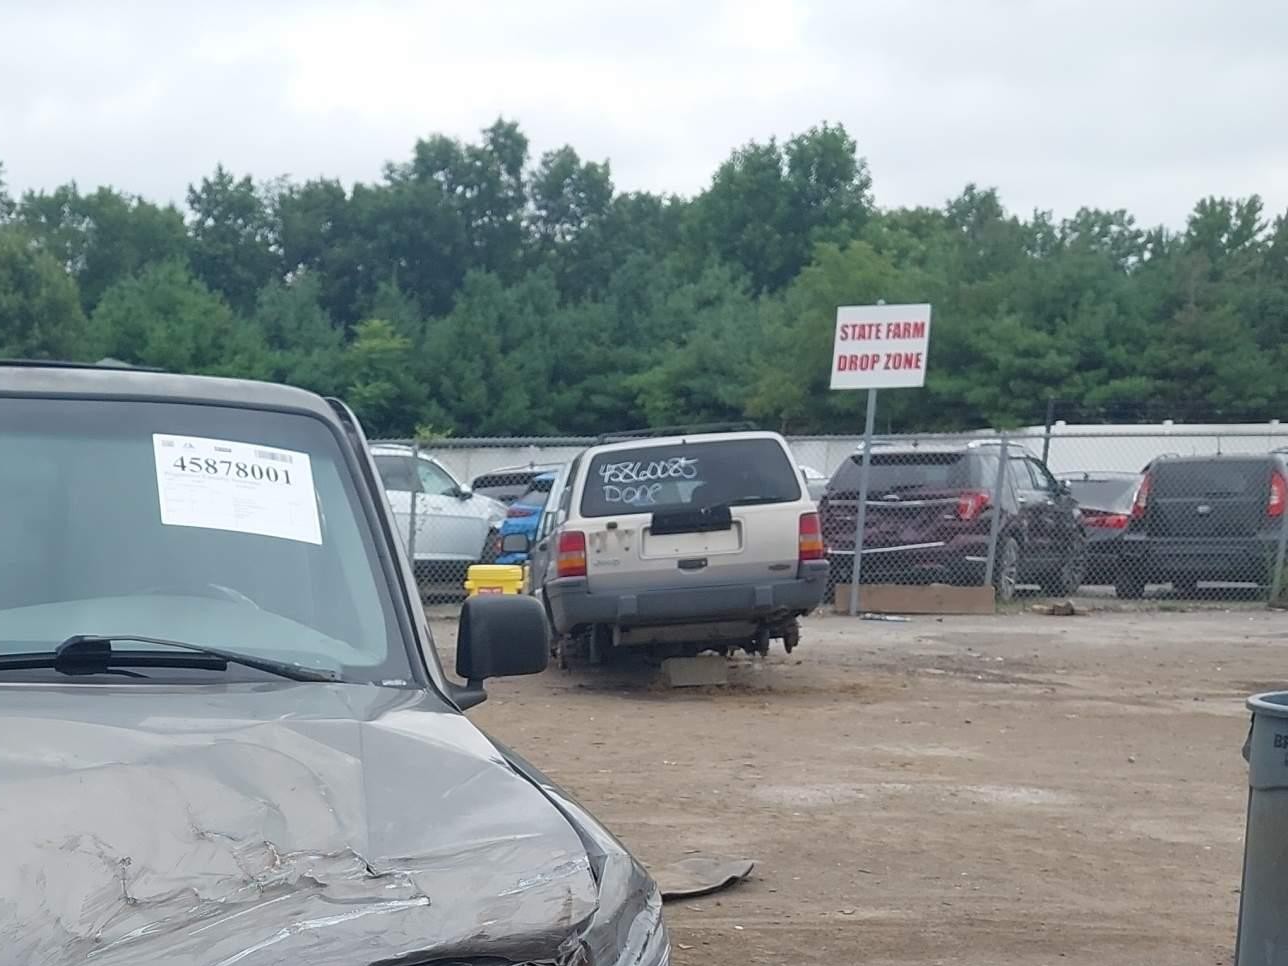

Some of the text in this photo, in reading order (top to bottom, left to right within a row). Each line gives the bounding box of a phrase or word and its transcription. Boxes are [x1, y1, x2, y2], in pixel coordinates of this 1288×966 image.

[840, 321, 925, 341] STATE FARM
[837, 352, 922, 372] DROP ZONE
[173, 455, 292, 485] 45878001
